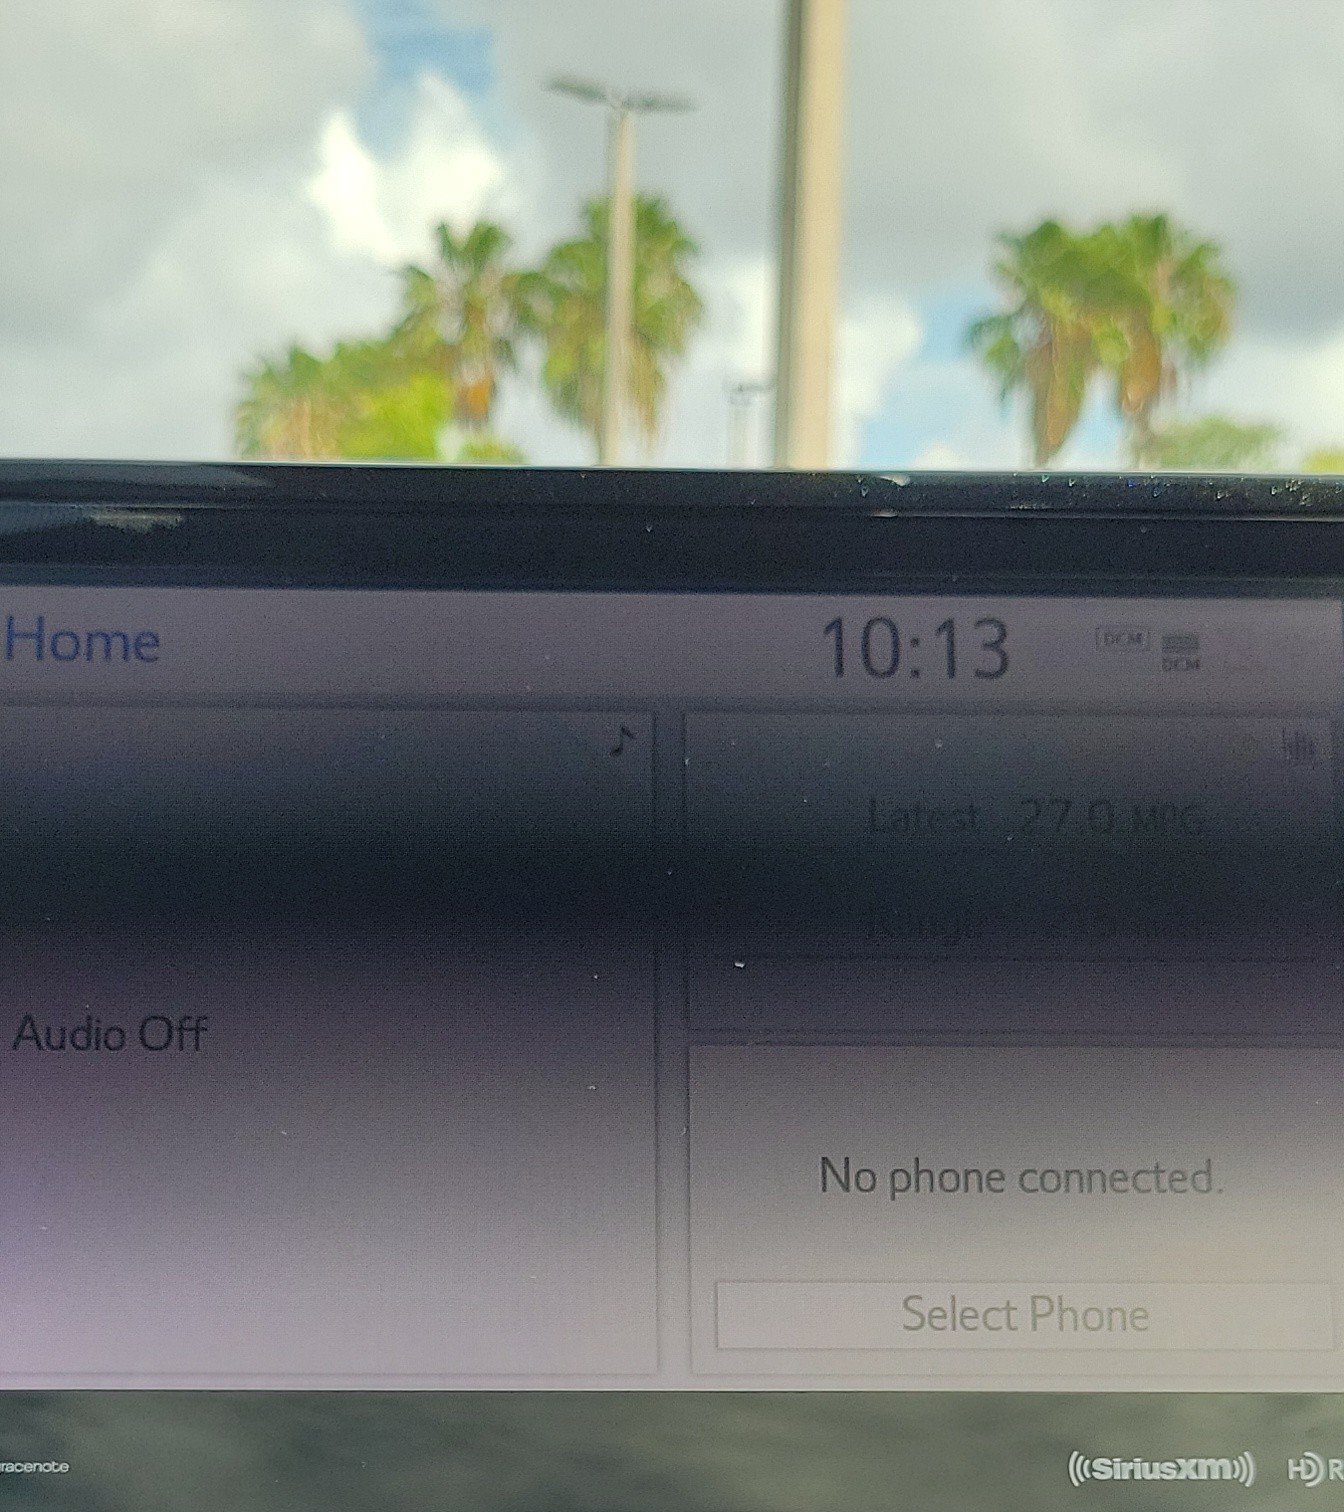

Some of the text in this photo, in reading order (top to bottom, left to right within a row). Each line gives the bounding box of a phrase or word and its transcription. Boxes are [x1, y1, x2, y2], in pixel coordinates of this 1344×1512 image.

[4, 614, 161, 664] Home
[822, 615, 1011, 681] 10:13
[867, 796, 982, 837] Latest
[11, 1013, 210, 1053] Audio Off
[818, 1156, 1226, 1202] No phone connected.
[901, 1293, 1151, 1334] Select Phone
